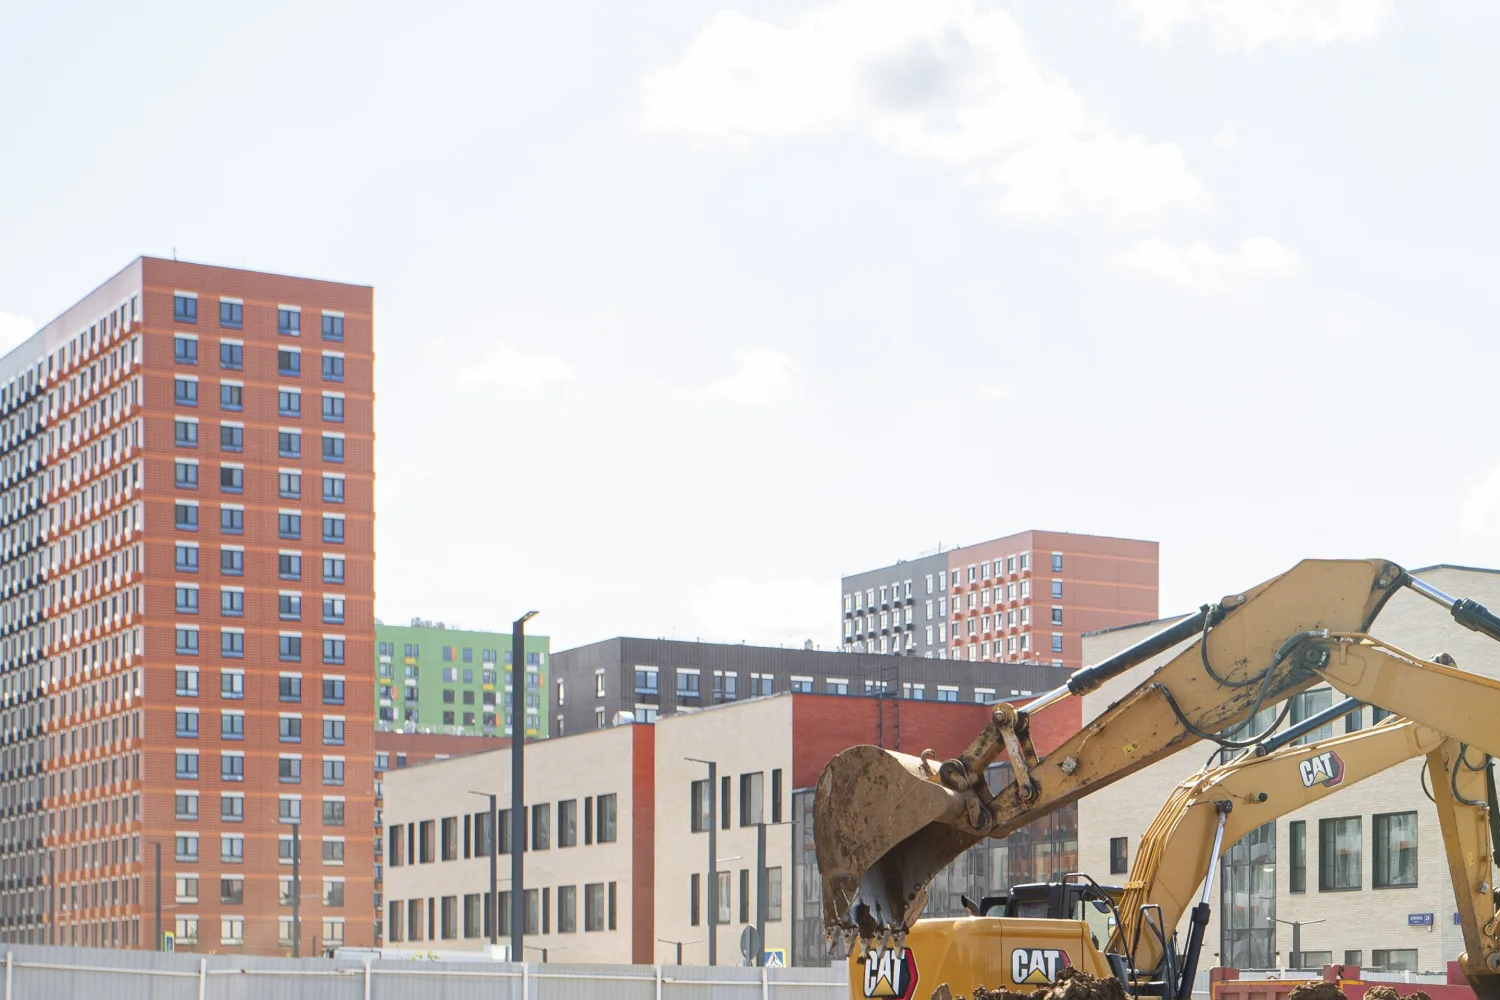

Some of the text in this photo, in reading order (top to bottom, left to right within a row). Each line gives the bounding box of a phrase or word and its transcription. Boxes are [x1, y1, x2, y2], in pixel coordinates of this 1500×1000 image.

[1299, 752, 1333, 787] CAT
[864, 949, 906, 997] CAT
[1012, 949, 1060, 984] CAT
